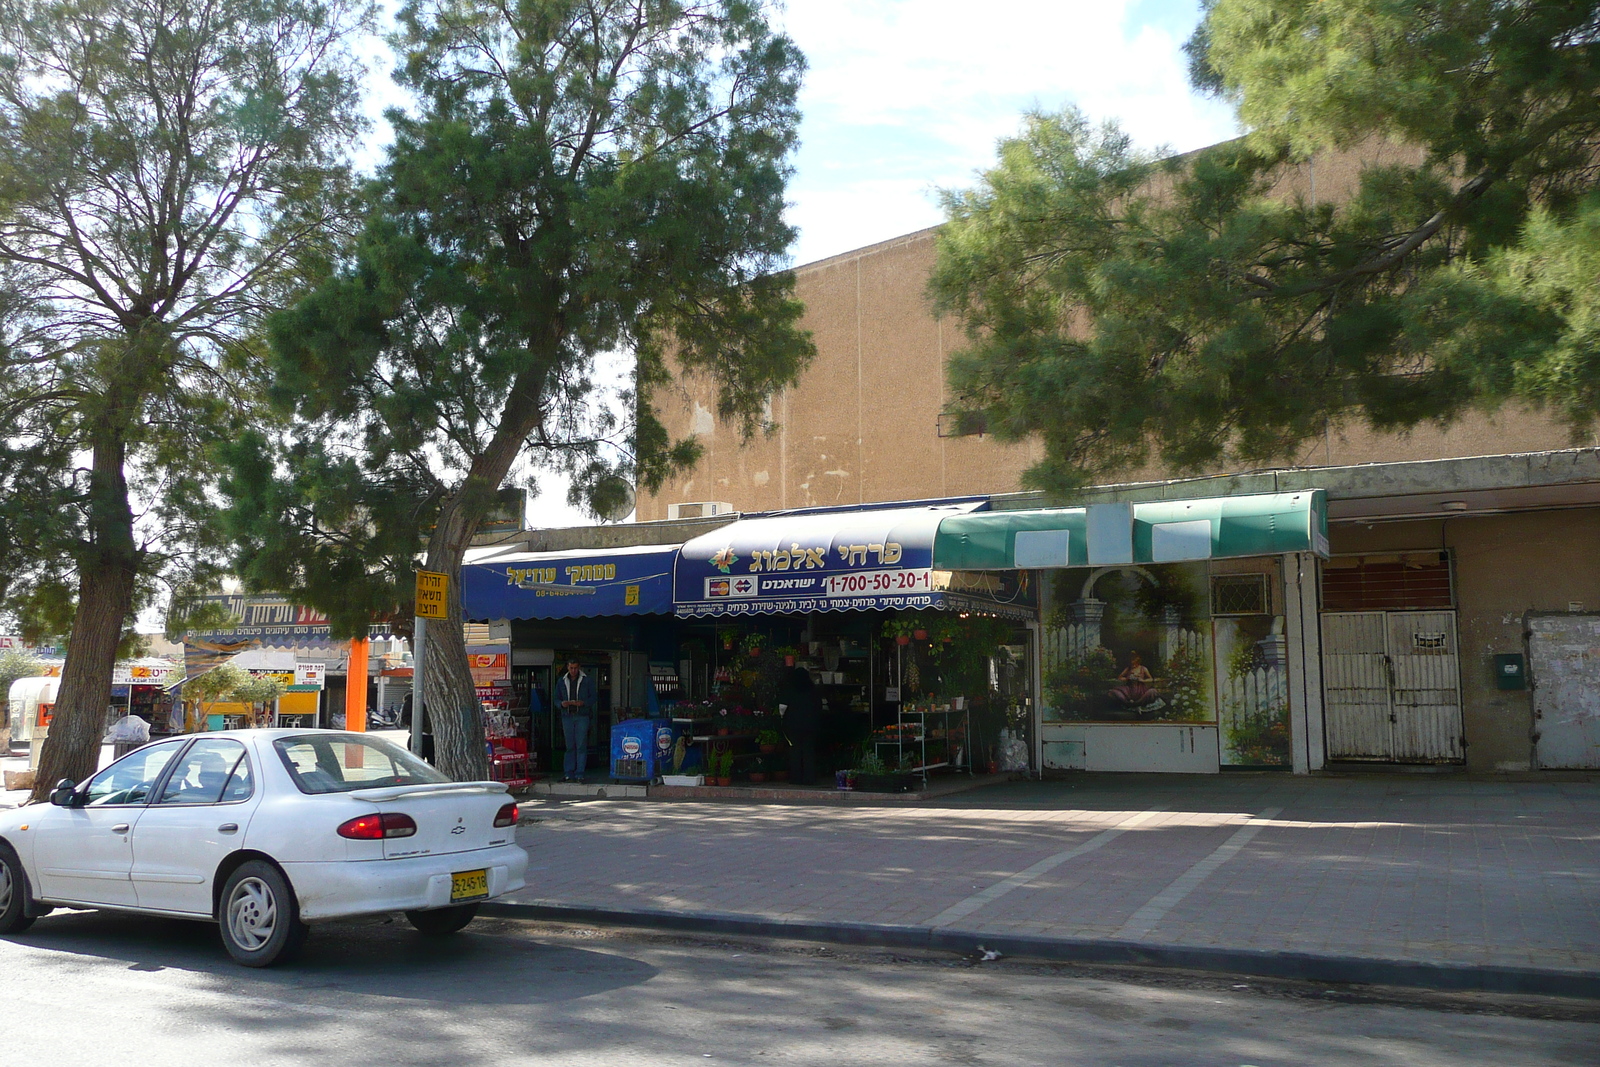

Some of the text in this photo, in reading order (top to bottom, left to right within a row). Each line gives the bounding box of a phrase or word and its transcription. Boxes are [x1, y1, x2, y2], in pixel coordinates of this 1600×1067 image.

[749, 542, 903, 572] פרחי אלמוג
[761, 578, 816, 590] ישראכרט
[829, 571, 929, 593] 1-700-50-20-1
[906, 596, 931, 605] פרחים
[727, 603, 749, 612] פרחים
